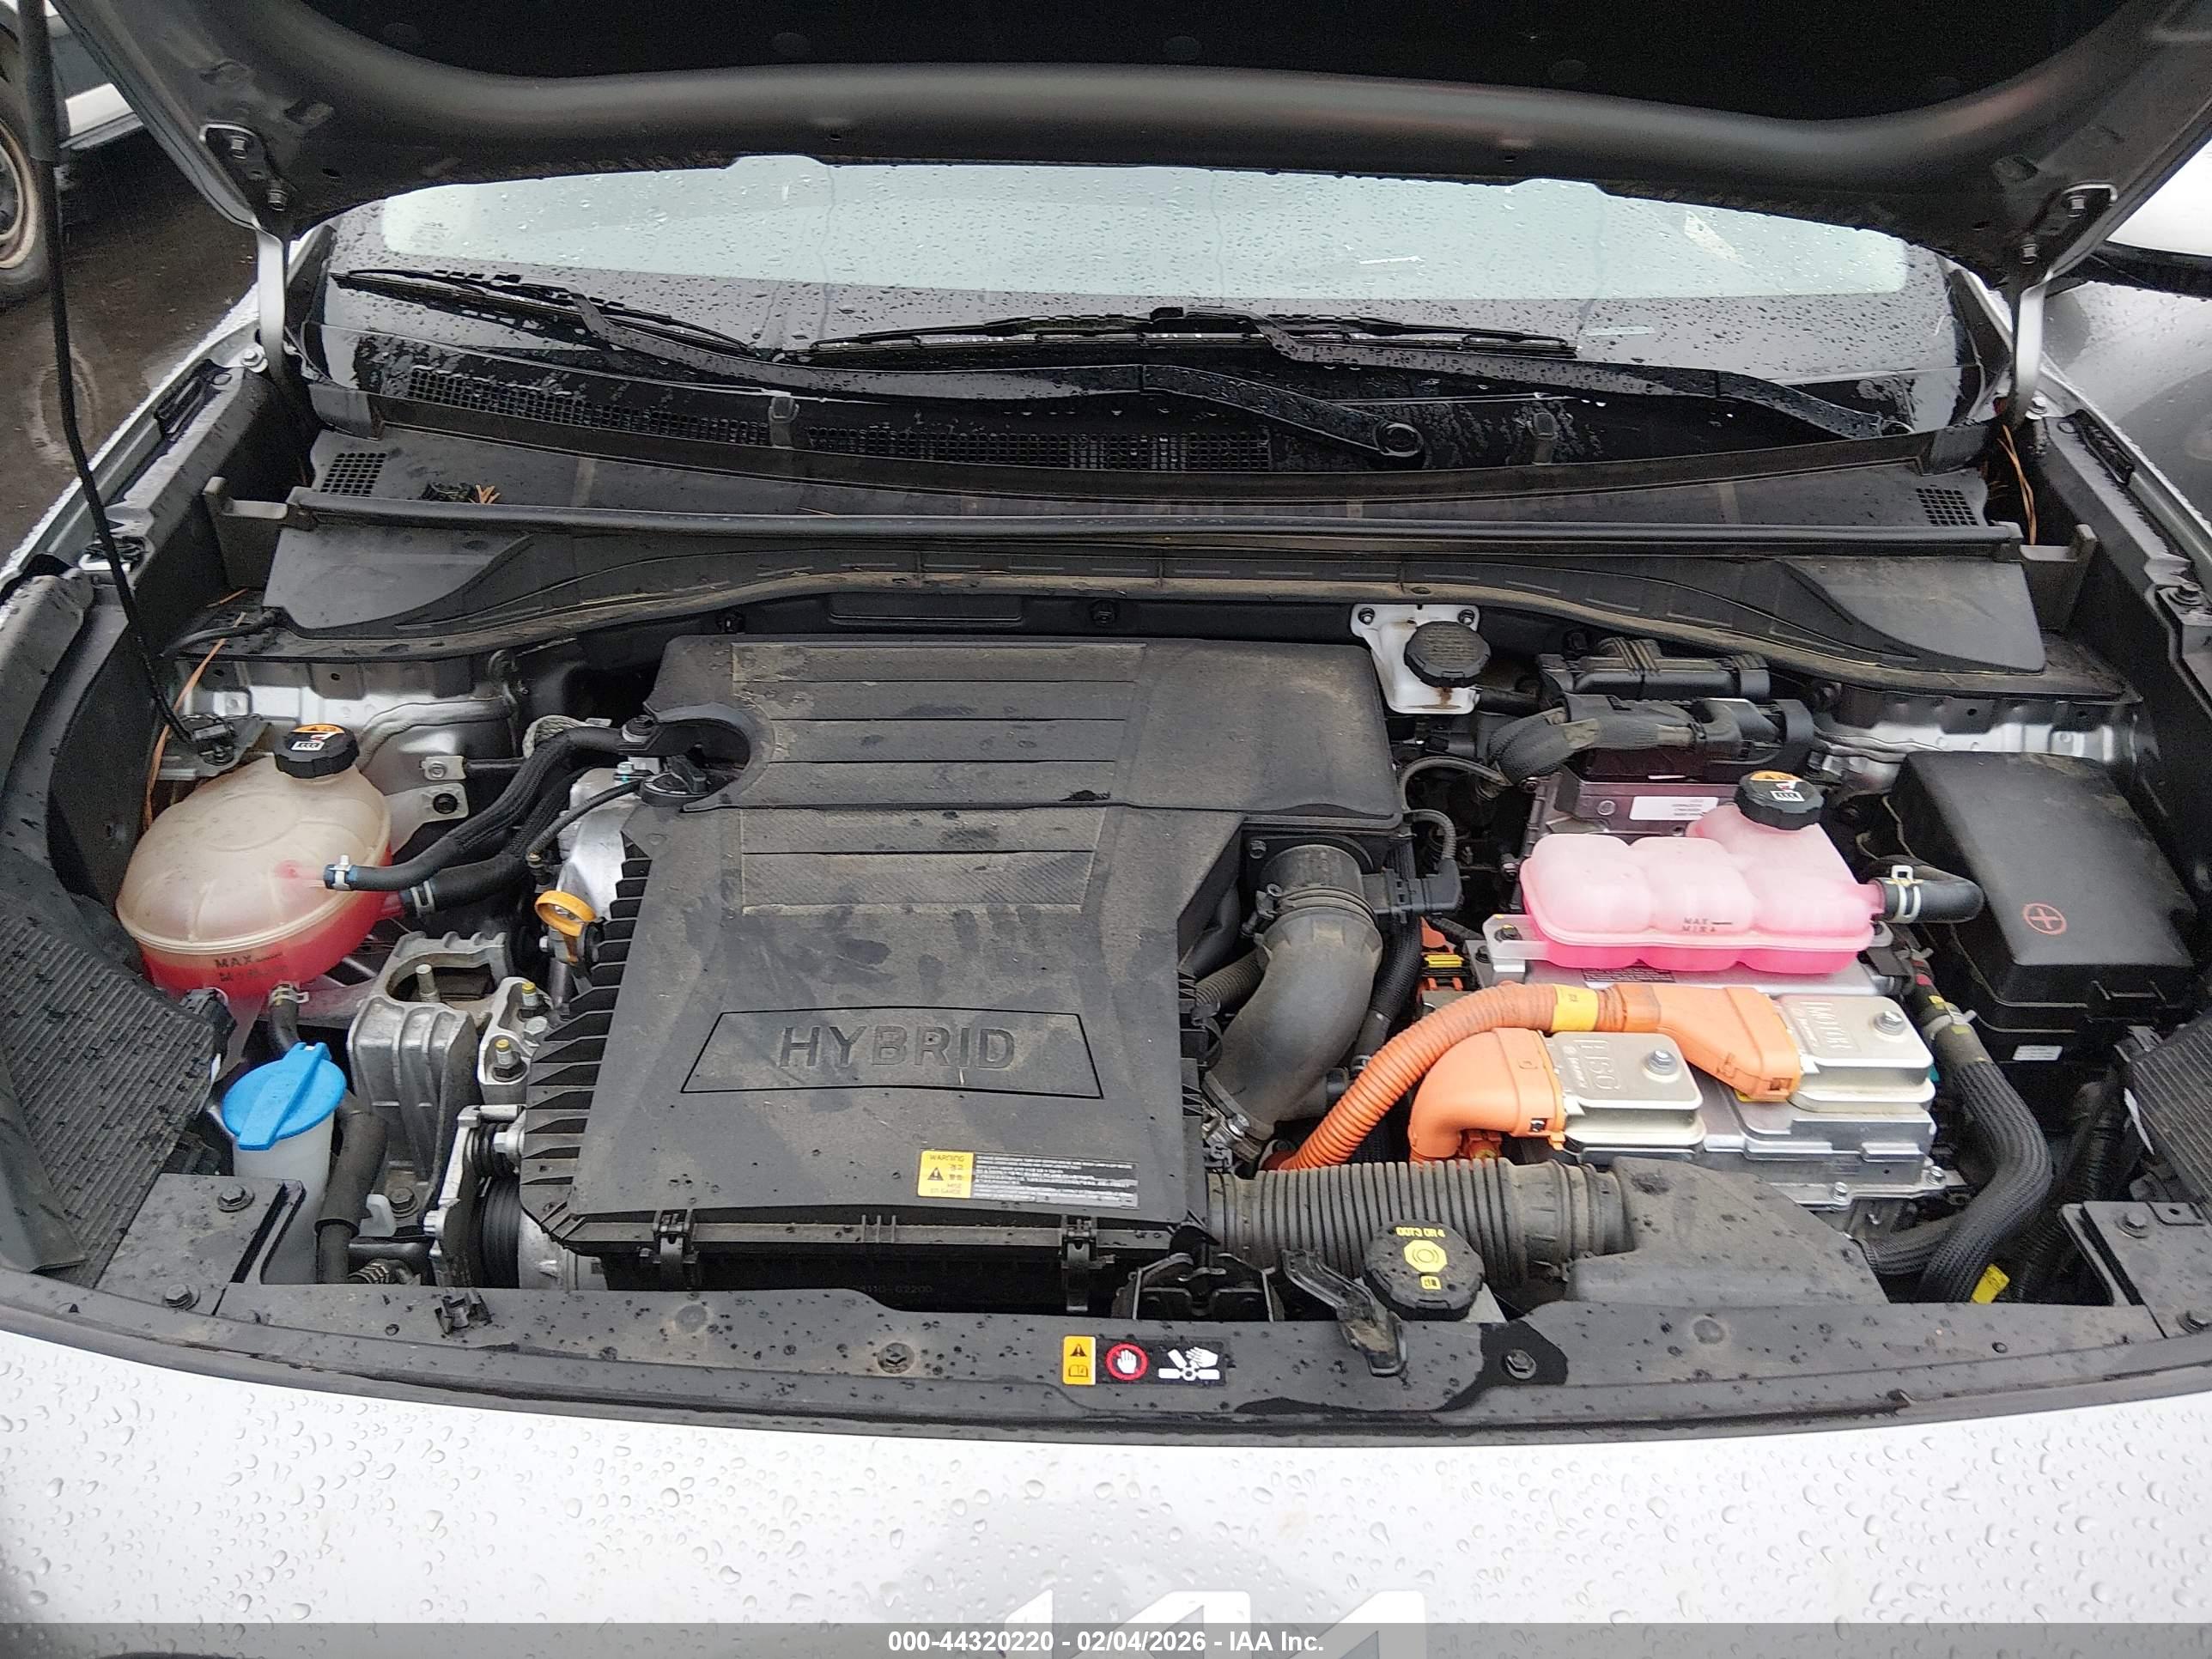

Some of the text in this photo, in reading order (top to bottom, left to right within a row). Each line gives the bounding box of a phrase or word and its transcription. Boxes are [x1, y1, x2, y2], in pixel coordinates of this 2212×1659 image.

[215, 955, 251, 968] MAX
[780, 1025, 1016, 1069] HYBRID
[929, 1154, 965, 1163] WARNING
